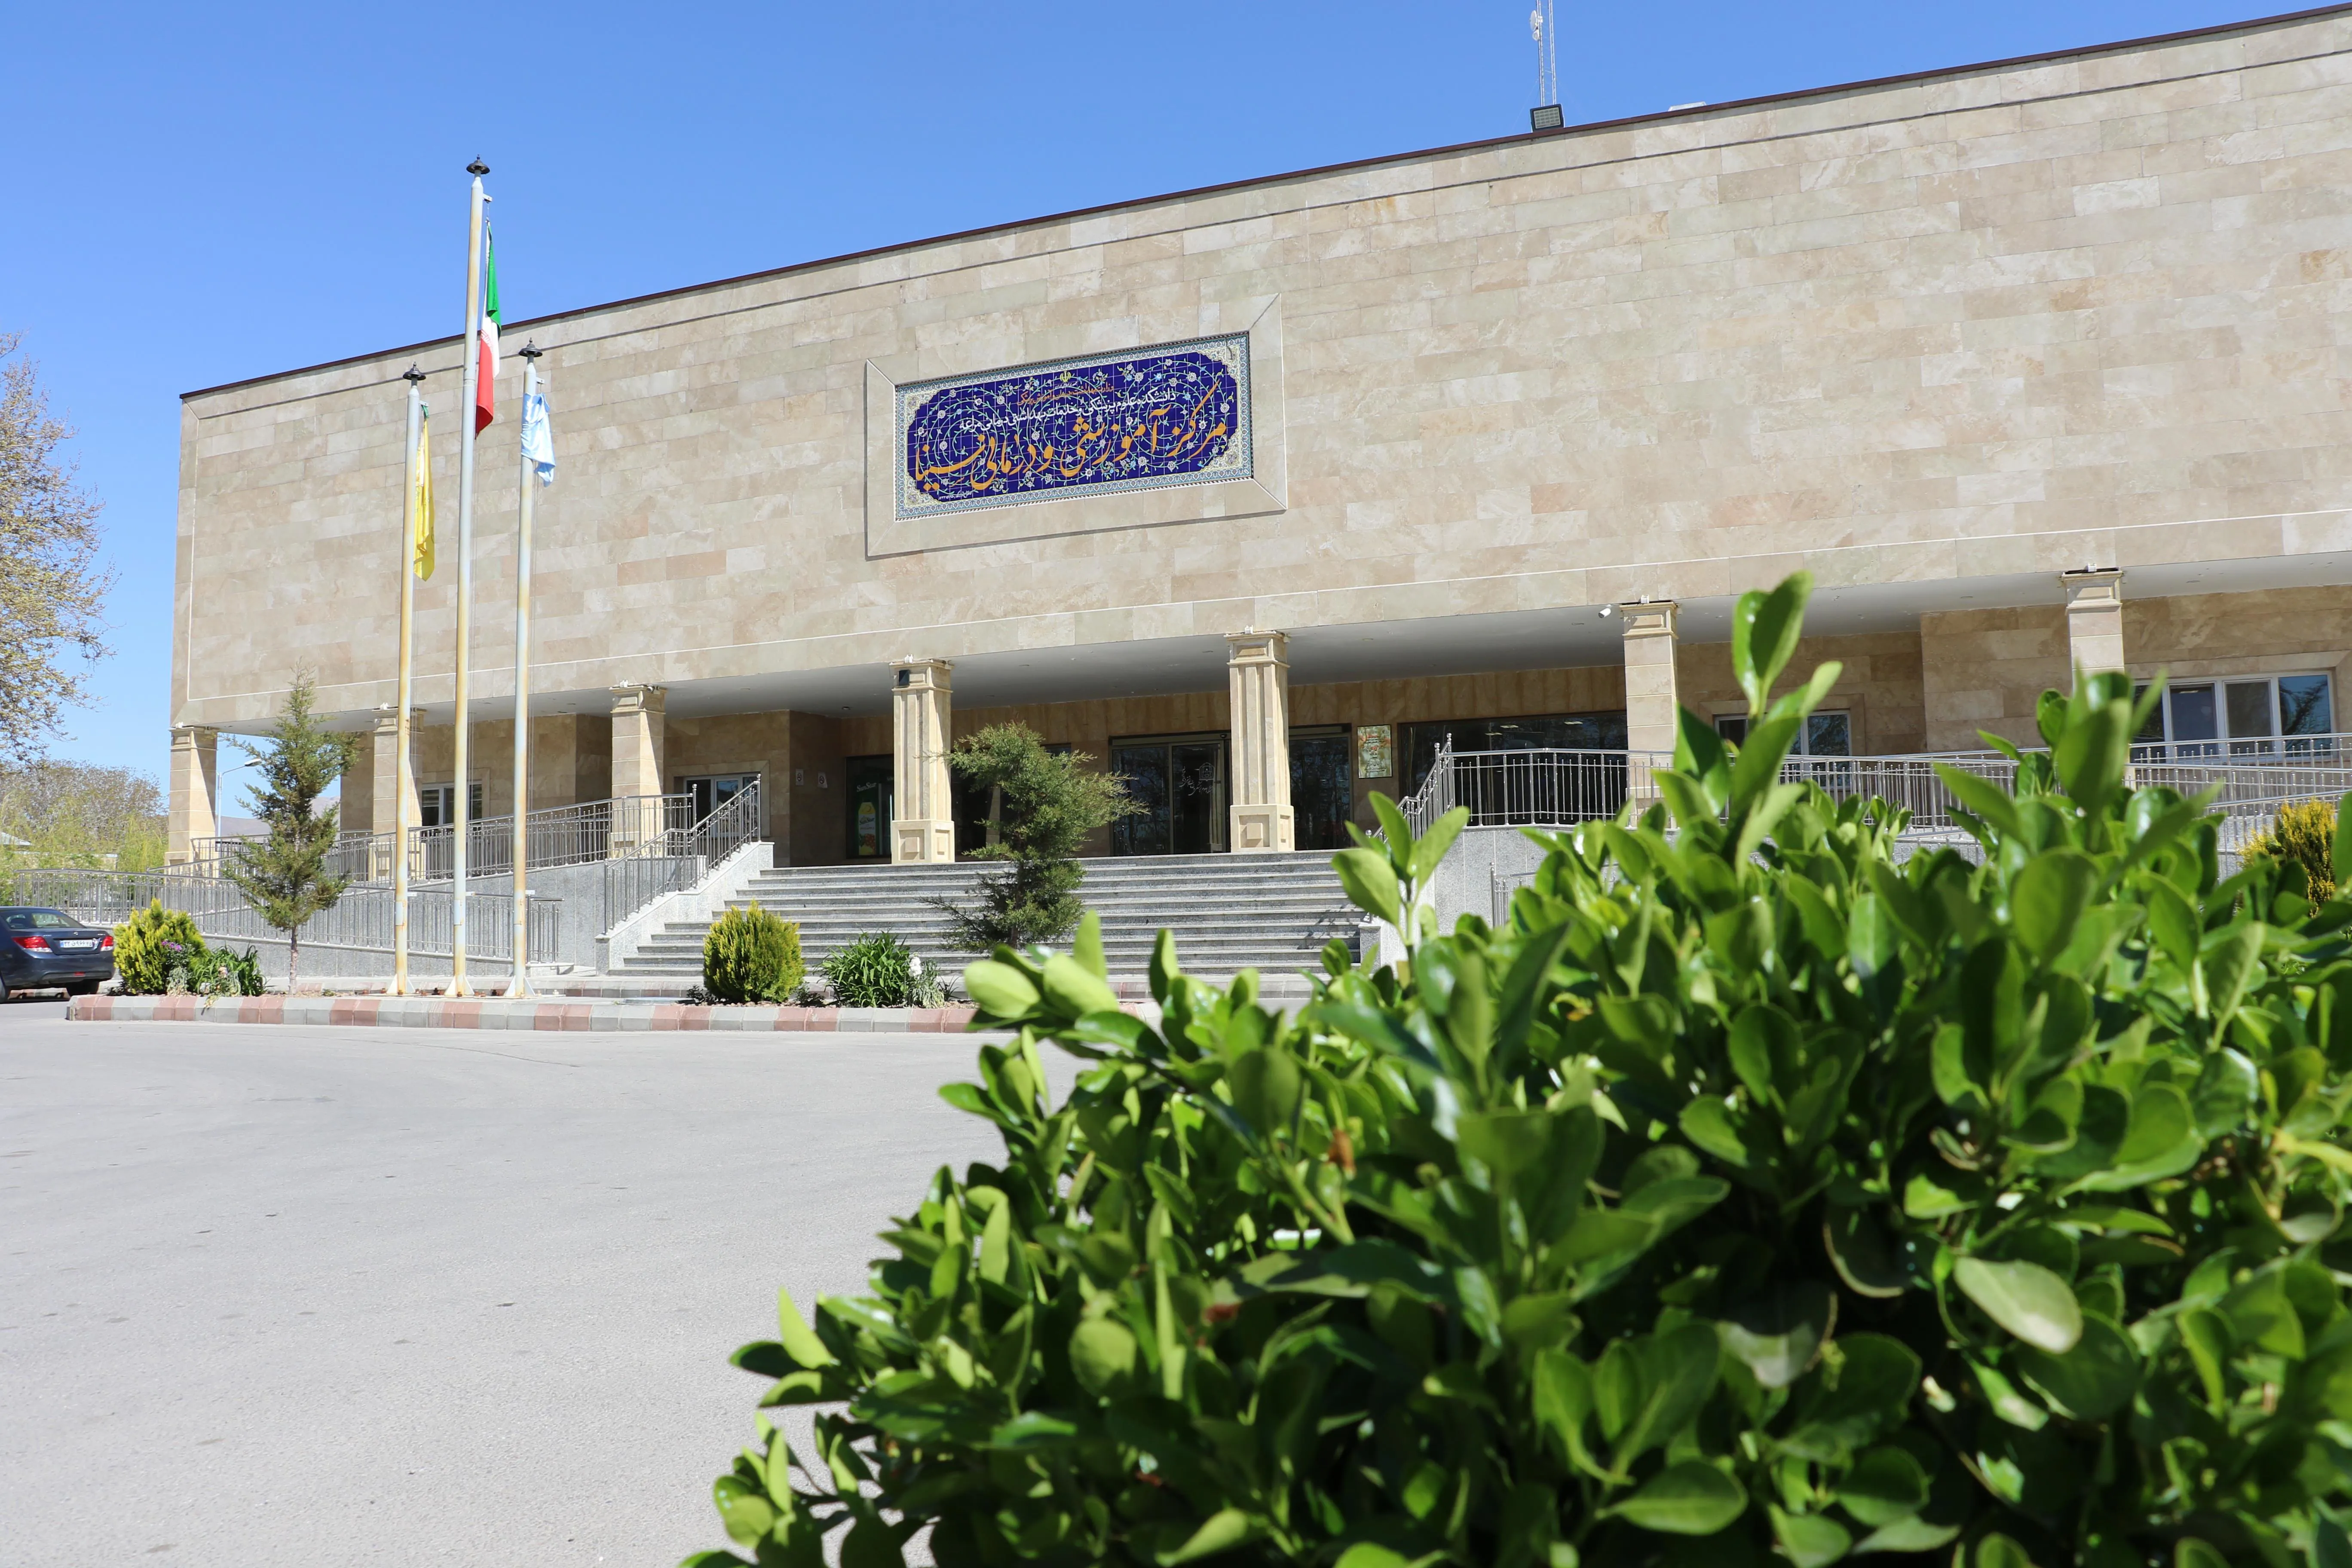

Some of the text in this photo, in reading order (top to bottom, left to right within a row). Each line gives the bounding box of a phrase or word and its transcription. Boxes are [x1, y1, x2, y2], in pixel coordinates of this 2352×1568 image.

[1116, 393, 1137, 412] علوم
[1137, 386, 1176, 405] دانشکده
[1047, 401, 1077, 418] خدمات
[1082, 396, 1116, 416] پزشکی
[959, 415, 982, 432] مراغه
[980, 413, 1008, 431] درمانی
[1167, 379, 1226, 459] مرکز
[1060, 404, 1171, 478] آموزشی
[915, 436, 986, 490] سینا
[970, 434, 1036, 490] درمانی
